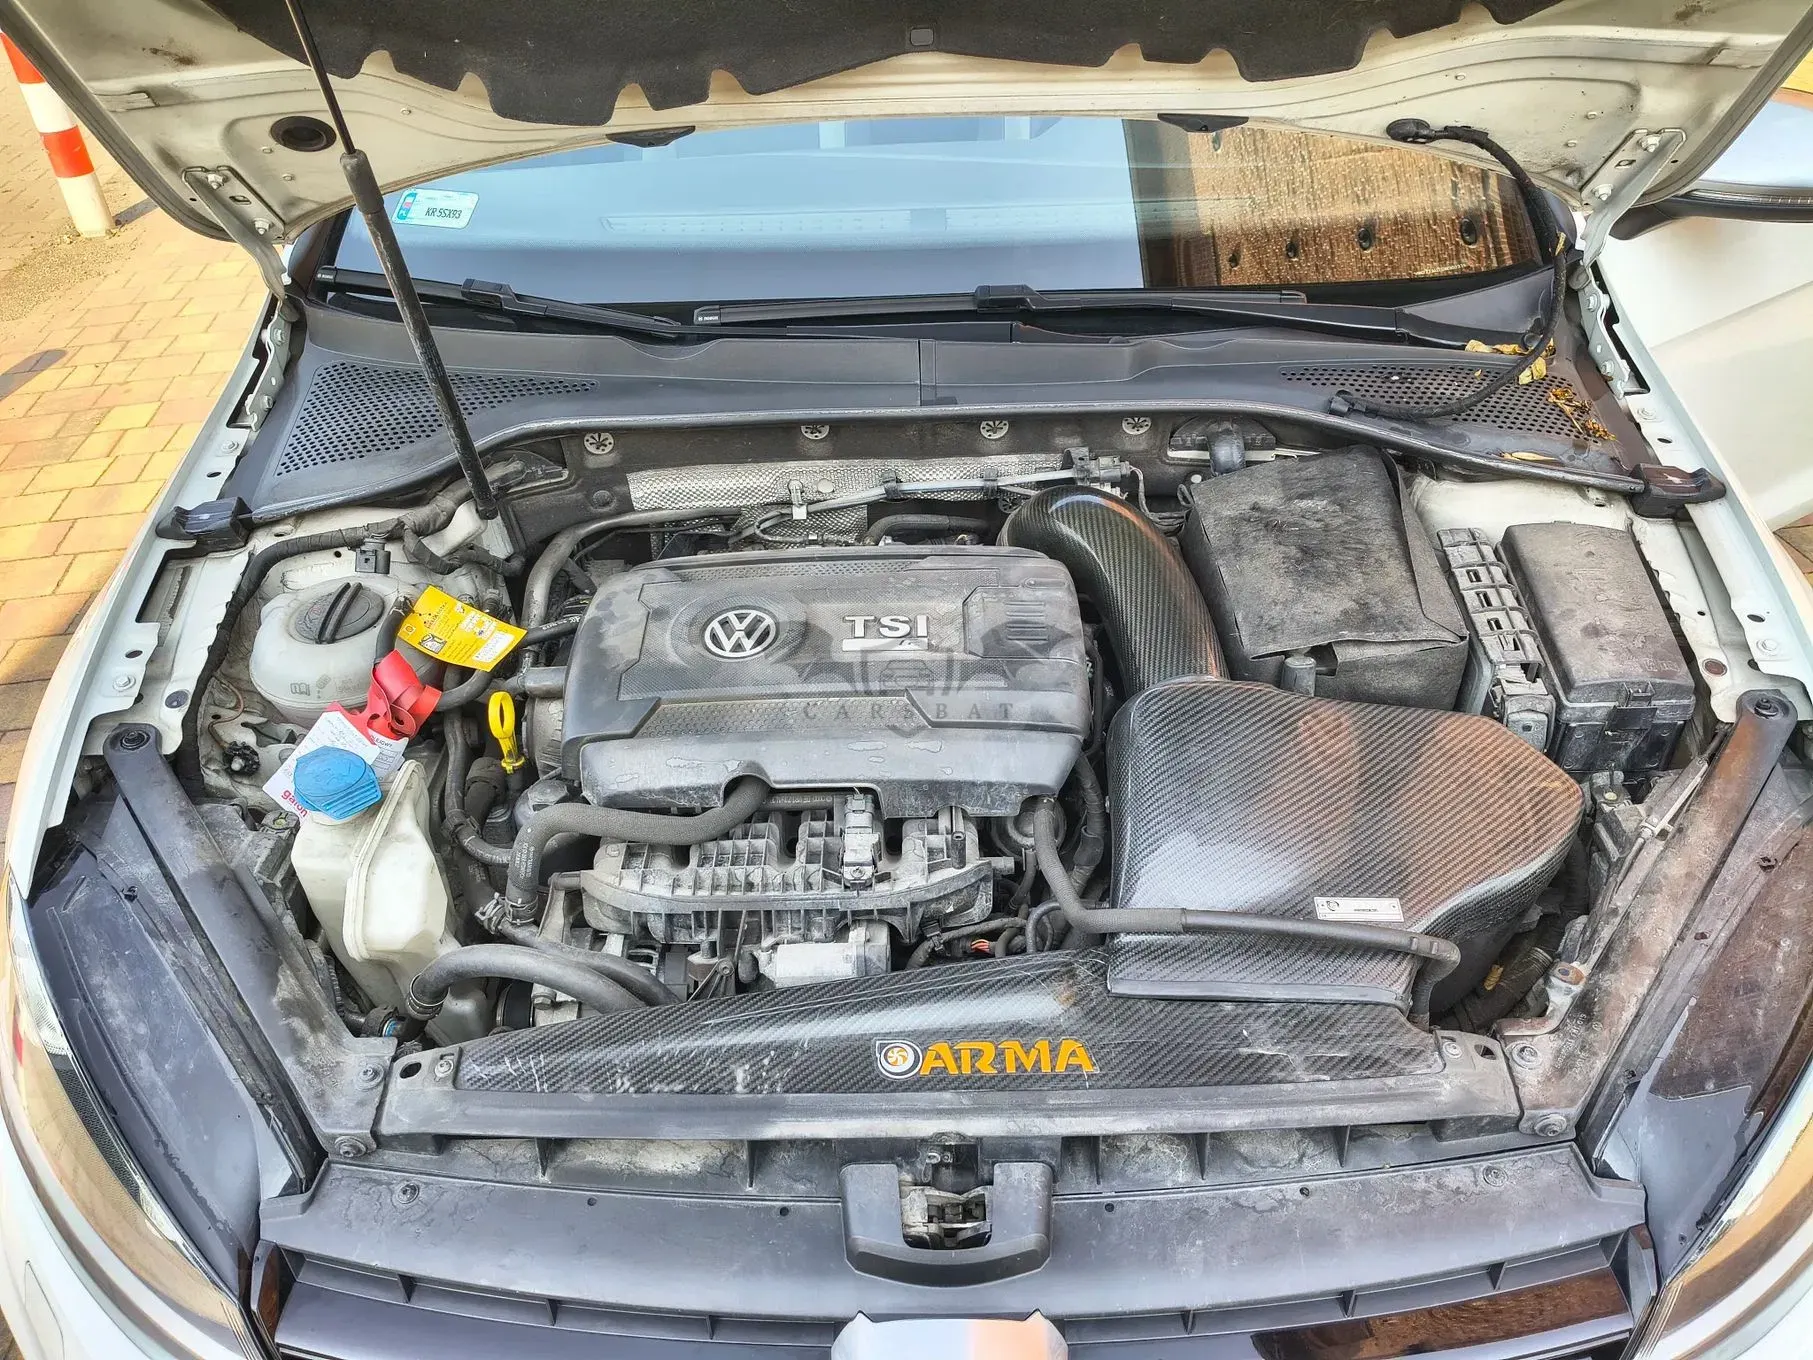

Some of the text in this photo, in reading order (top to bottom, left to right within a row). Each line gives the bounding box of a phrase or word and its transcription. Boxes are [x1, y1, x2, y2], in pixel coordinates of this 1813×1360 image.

[425, 207, 437, 217] KR
[844, 614, 929, 638] TSI
[919, 1039, 1095, 1076] ARMA
